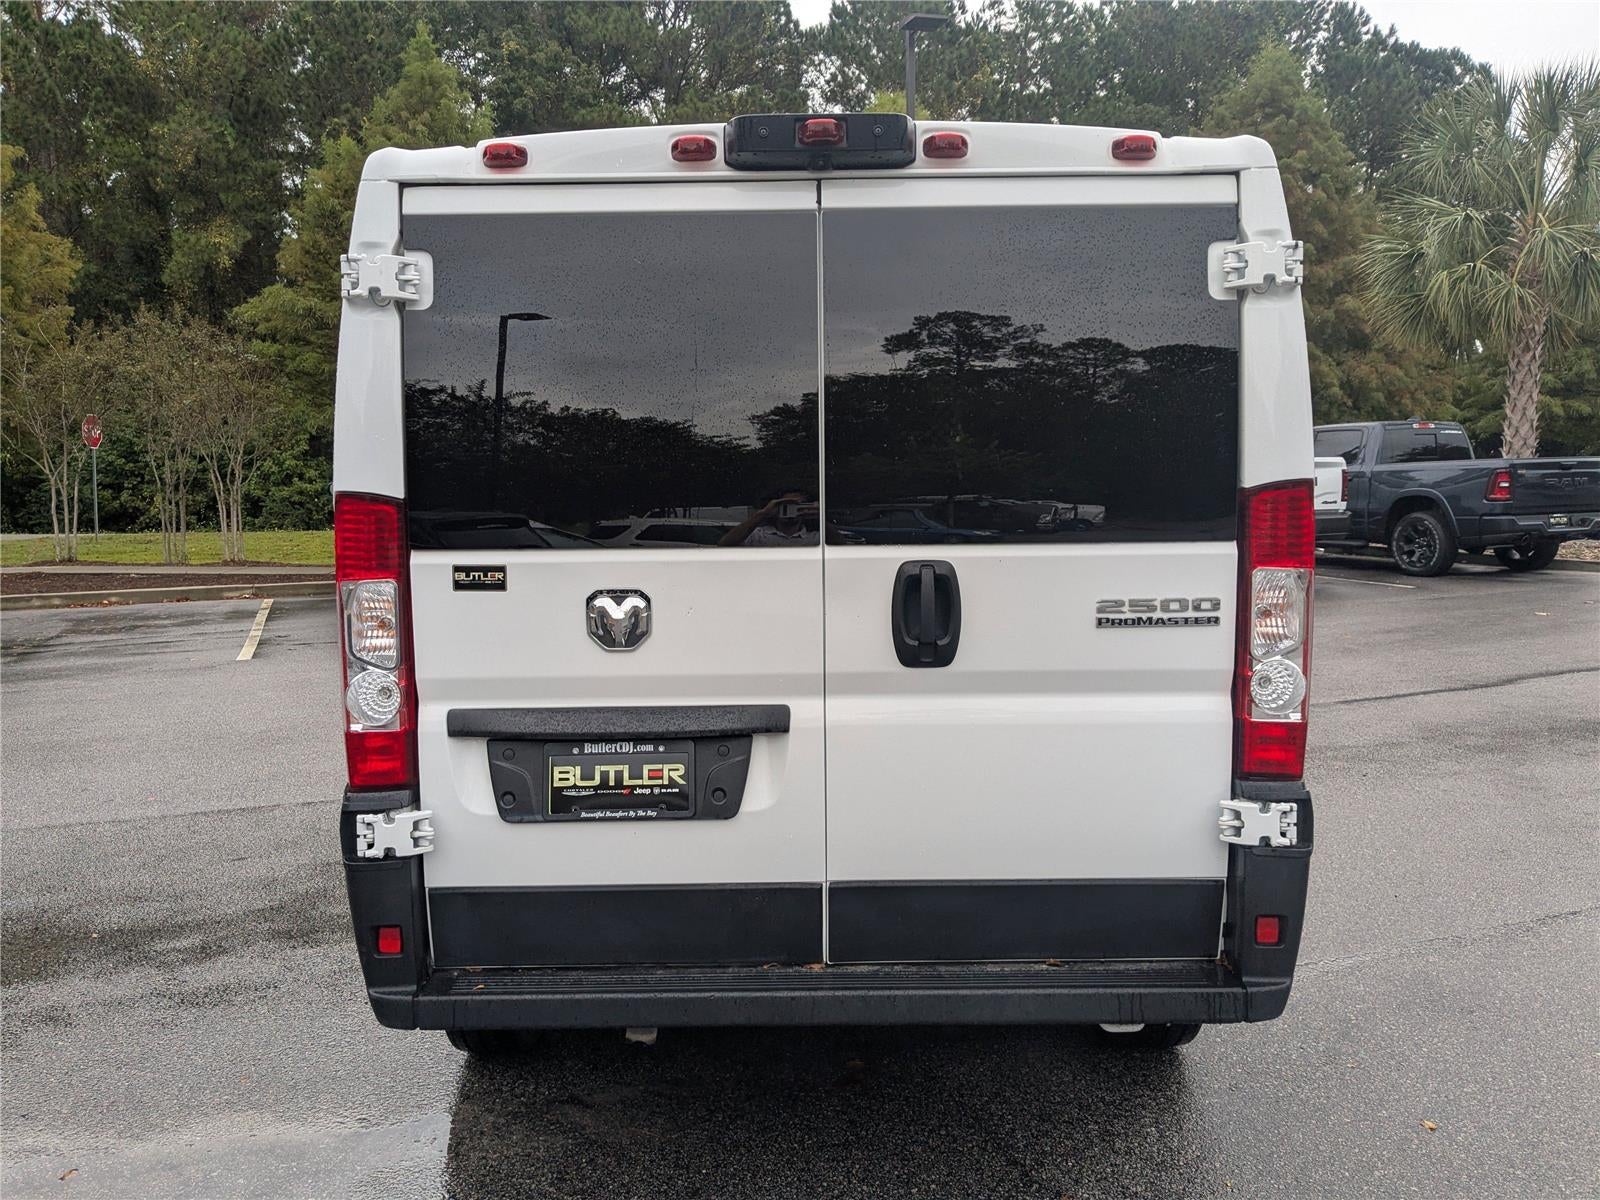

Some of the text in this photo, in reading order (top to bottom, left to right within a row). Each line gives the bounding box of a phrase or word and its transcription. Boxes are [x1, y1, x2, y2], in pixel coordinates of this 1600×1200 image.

[455, 572, 504, 580] BUTLER
[1096, 597, 1221, 614] 2500
[584, 742, 654, 753] ButlerCDJ.com
[553, 763, 687, 787] BUTLER
[633, 787, 651, 795] Jeep
